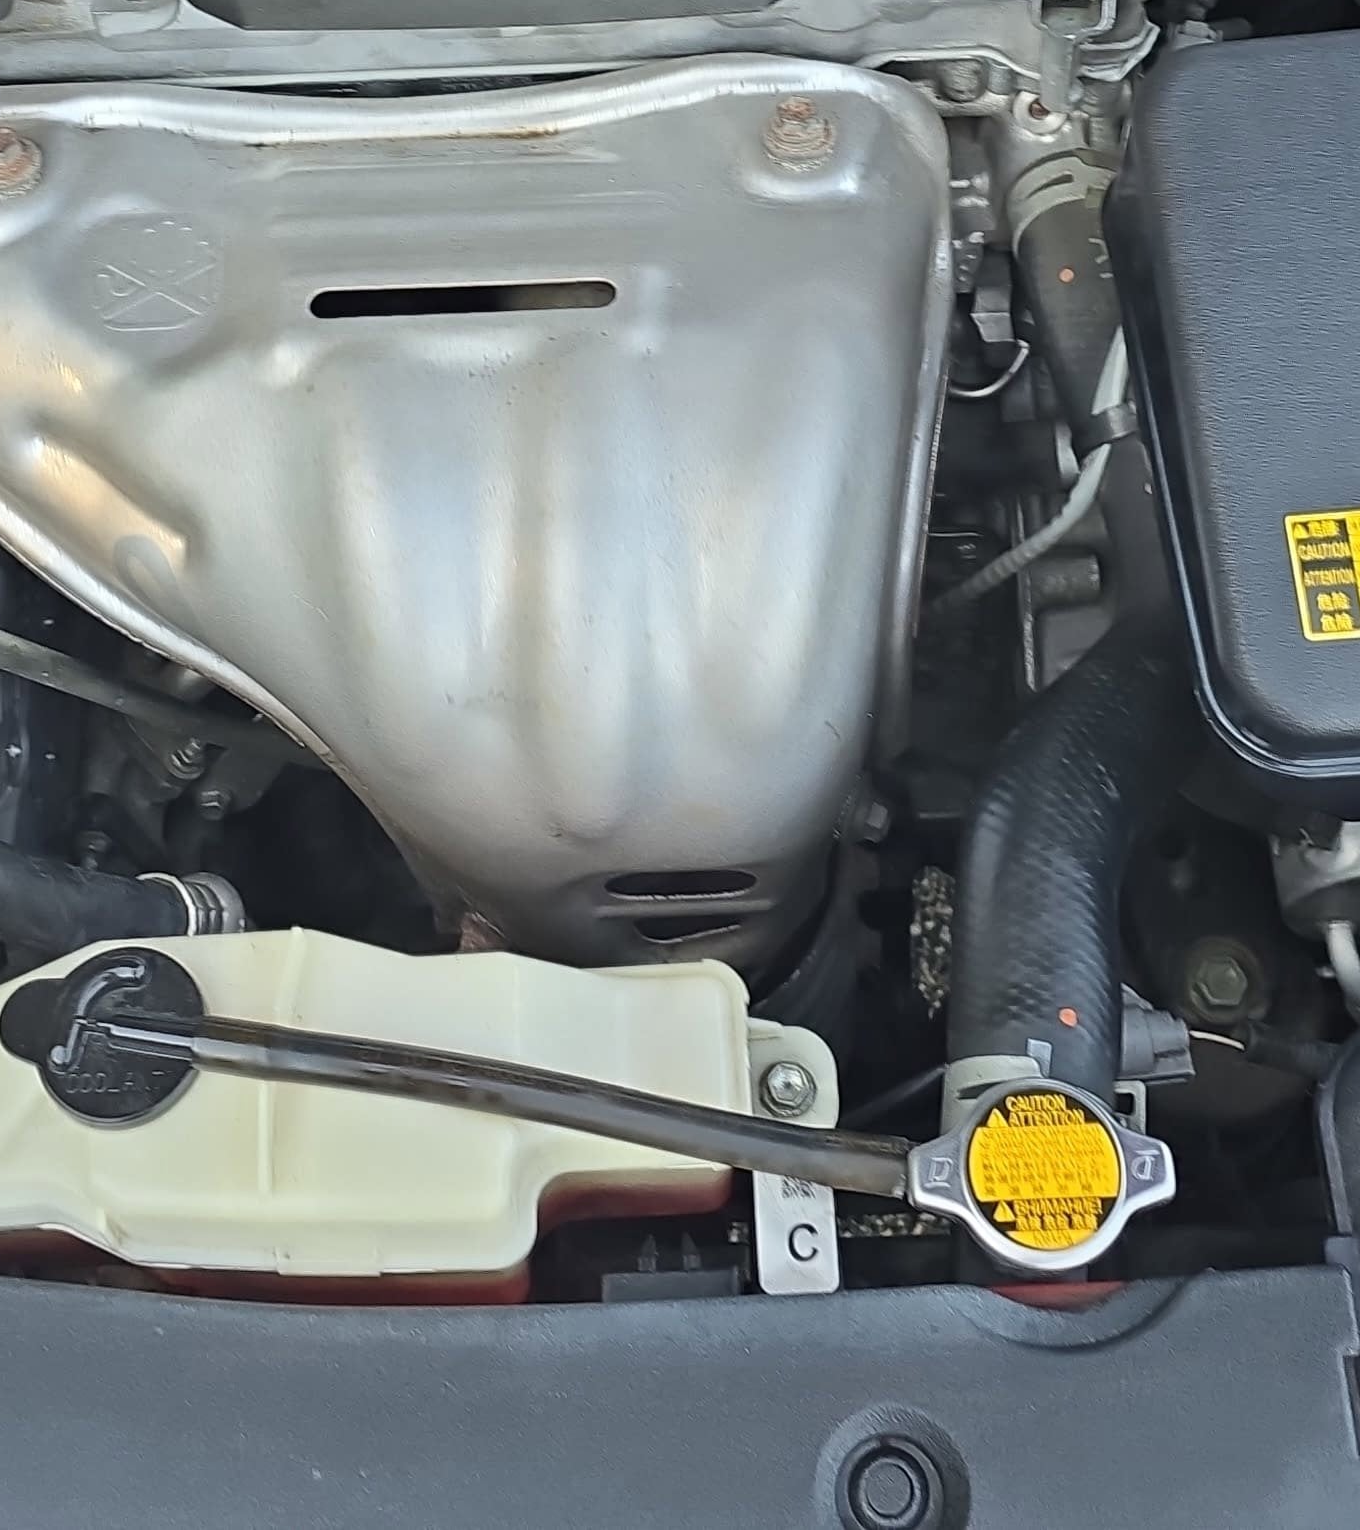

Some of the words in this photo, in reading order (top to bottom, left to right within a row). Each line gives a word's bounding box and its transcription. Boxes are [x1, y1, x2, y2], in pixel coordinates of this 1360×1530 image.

[1298, 541, 1352, 561] CAUTION
[1303, 568, 1356, 587] ATTENTION
[1005, 1094, 1067, 1112] CAUTION
[1008, 1108, 1086, 1127] ATTENTION
[788, 1223, 819, 1262] C
